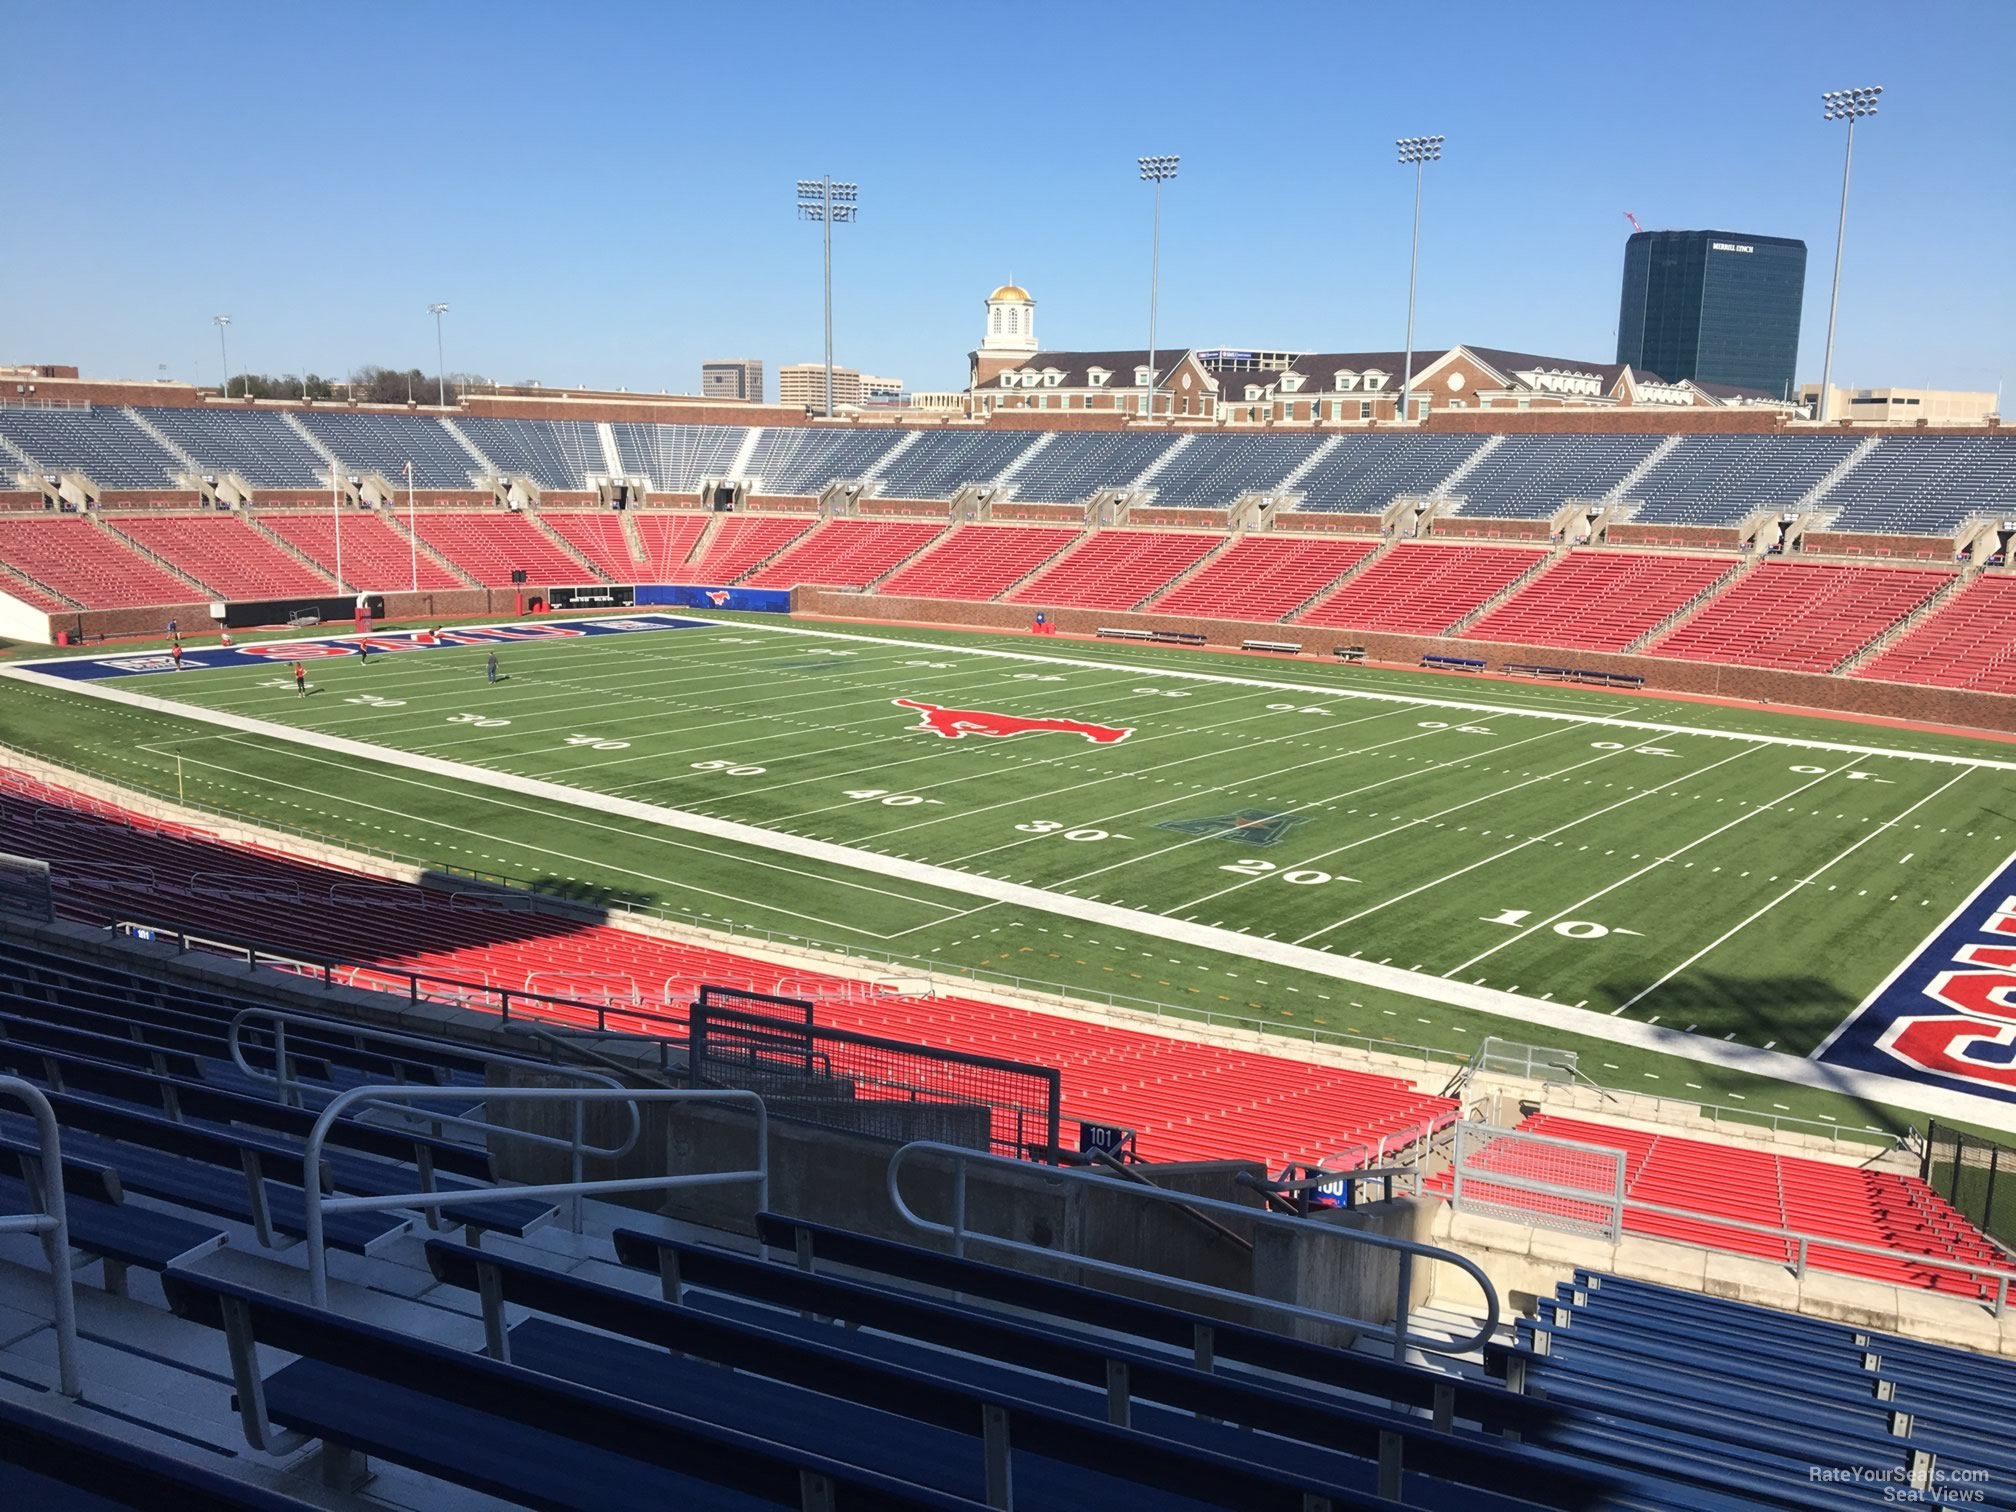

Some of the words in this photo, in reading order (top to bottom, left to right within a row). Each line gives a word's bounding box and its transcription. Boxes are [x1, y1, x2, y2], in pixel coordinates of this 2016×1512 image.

[235, 625, 586, 660] SMU
[344, 696, 407, 707] 20
[446, 714, 512, 727] 30
[563, 736, 631, 750] 40
[690, 759, 767, 776] 50
[842, 788, 925, 806] 40
[1014, 819, 1110, 842] 30
[1218, 859, 1332, 885] 20
[1478, 908, 1609, 939] 10
[1090, 1127, 1111, 1147] 101
